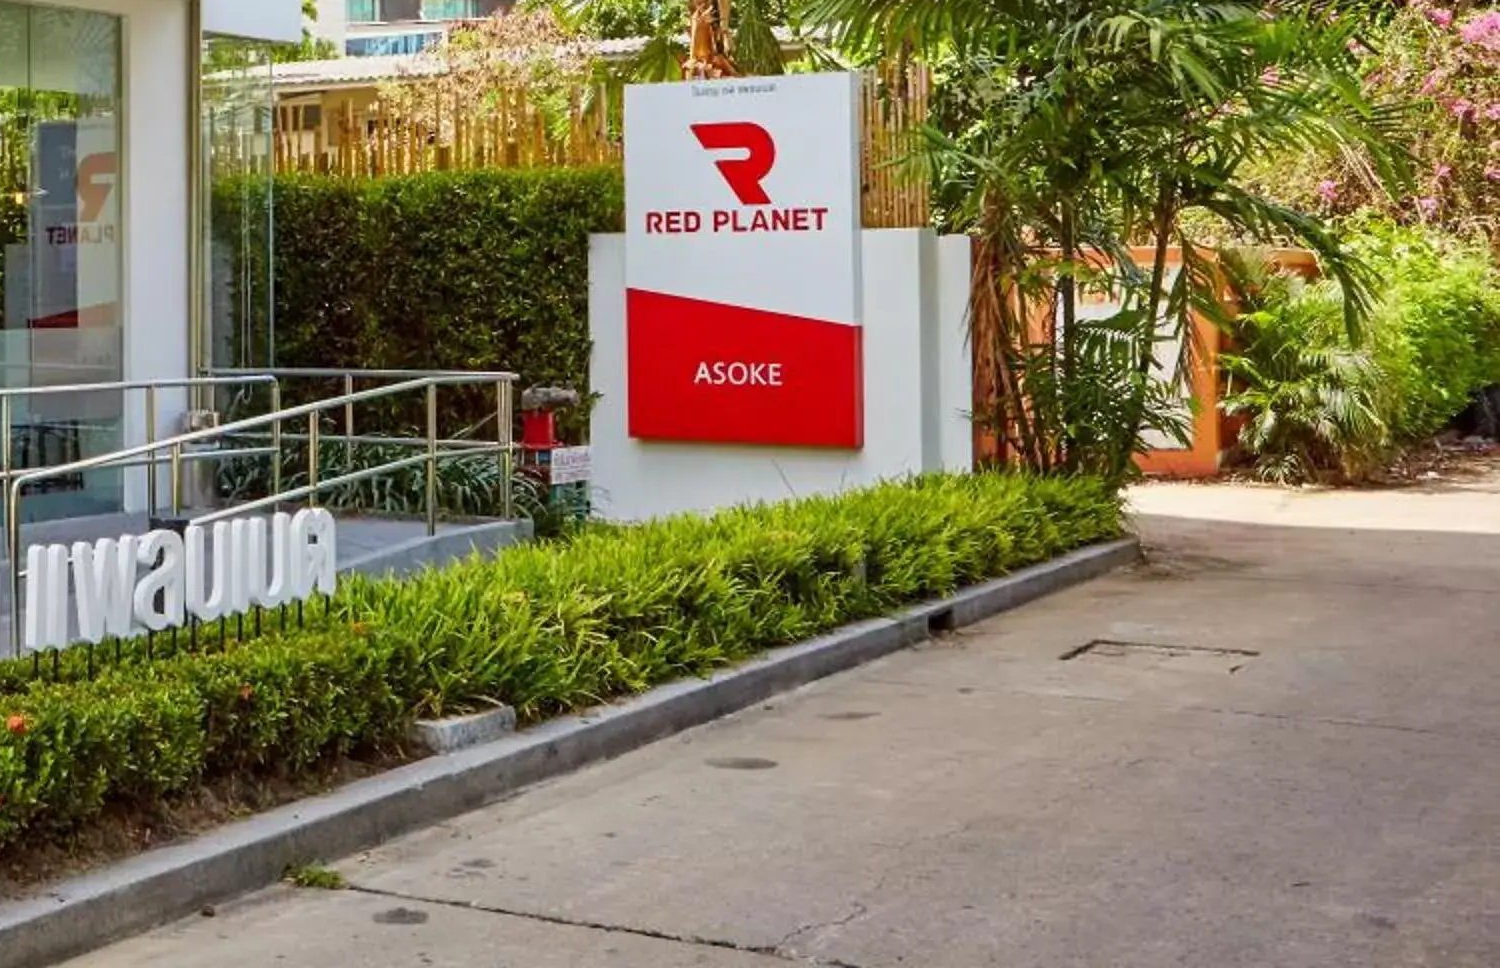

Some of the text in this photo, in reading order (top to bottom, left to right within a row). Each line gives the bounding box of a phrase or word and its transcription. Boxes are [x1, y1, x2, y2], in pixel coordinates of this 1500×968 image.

[646, 208, 828, 233] RED PLANET
[693, 361, 783, 386] ASOKE
